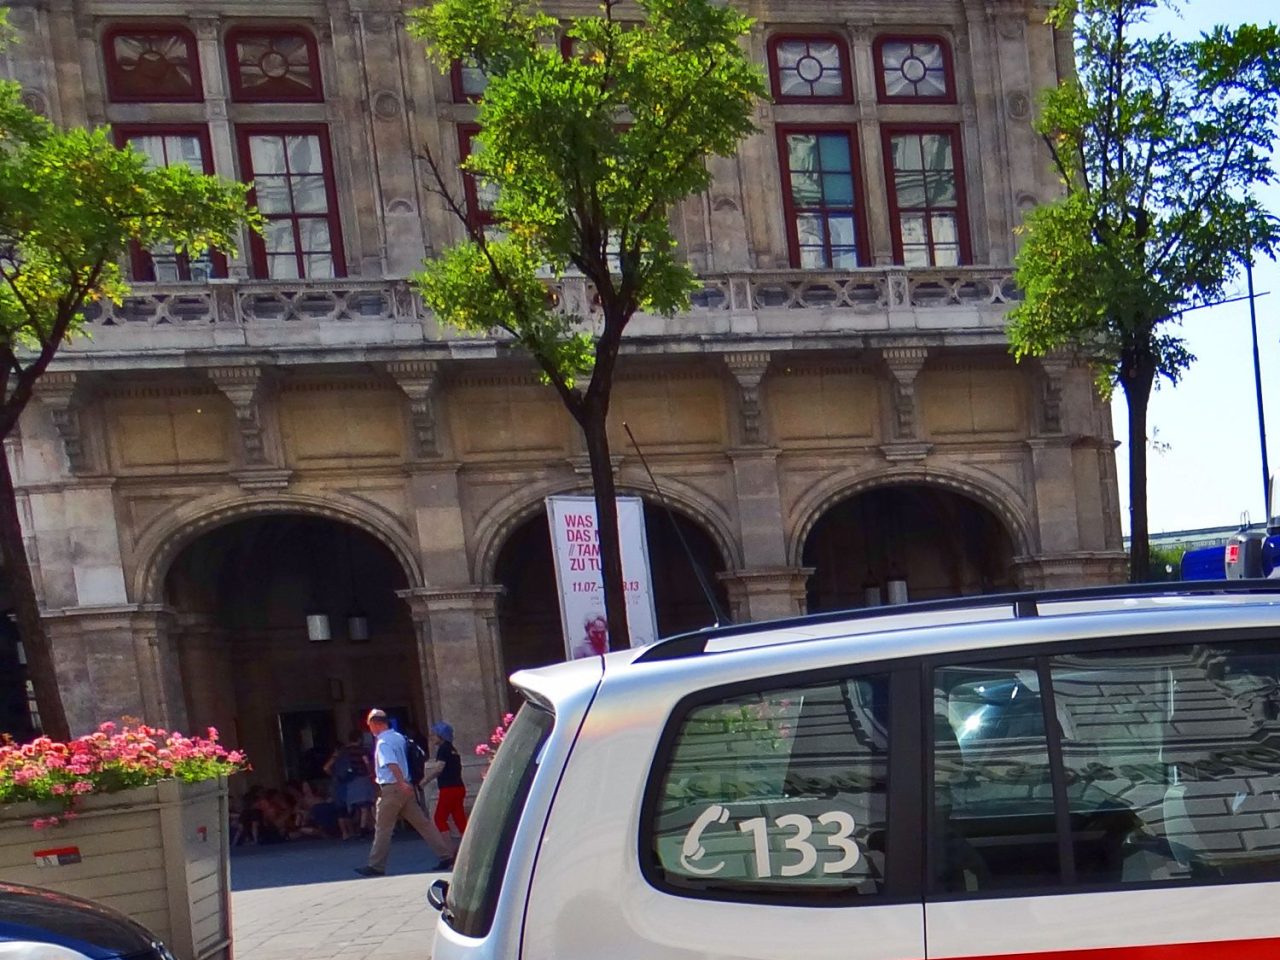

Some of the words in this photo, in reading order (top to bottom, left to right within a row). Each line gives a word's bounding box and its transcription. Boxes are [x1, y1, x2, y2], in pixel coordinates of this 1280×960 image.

[564, 514, 593, 528] WAS
[566, 529, 592, 543] DAS
[577, 543, 601, 557] TAM
[570, 558, 586, 571] ZU
[739, 810, 860, 878] 133
